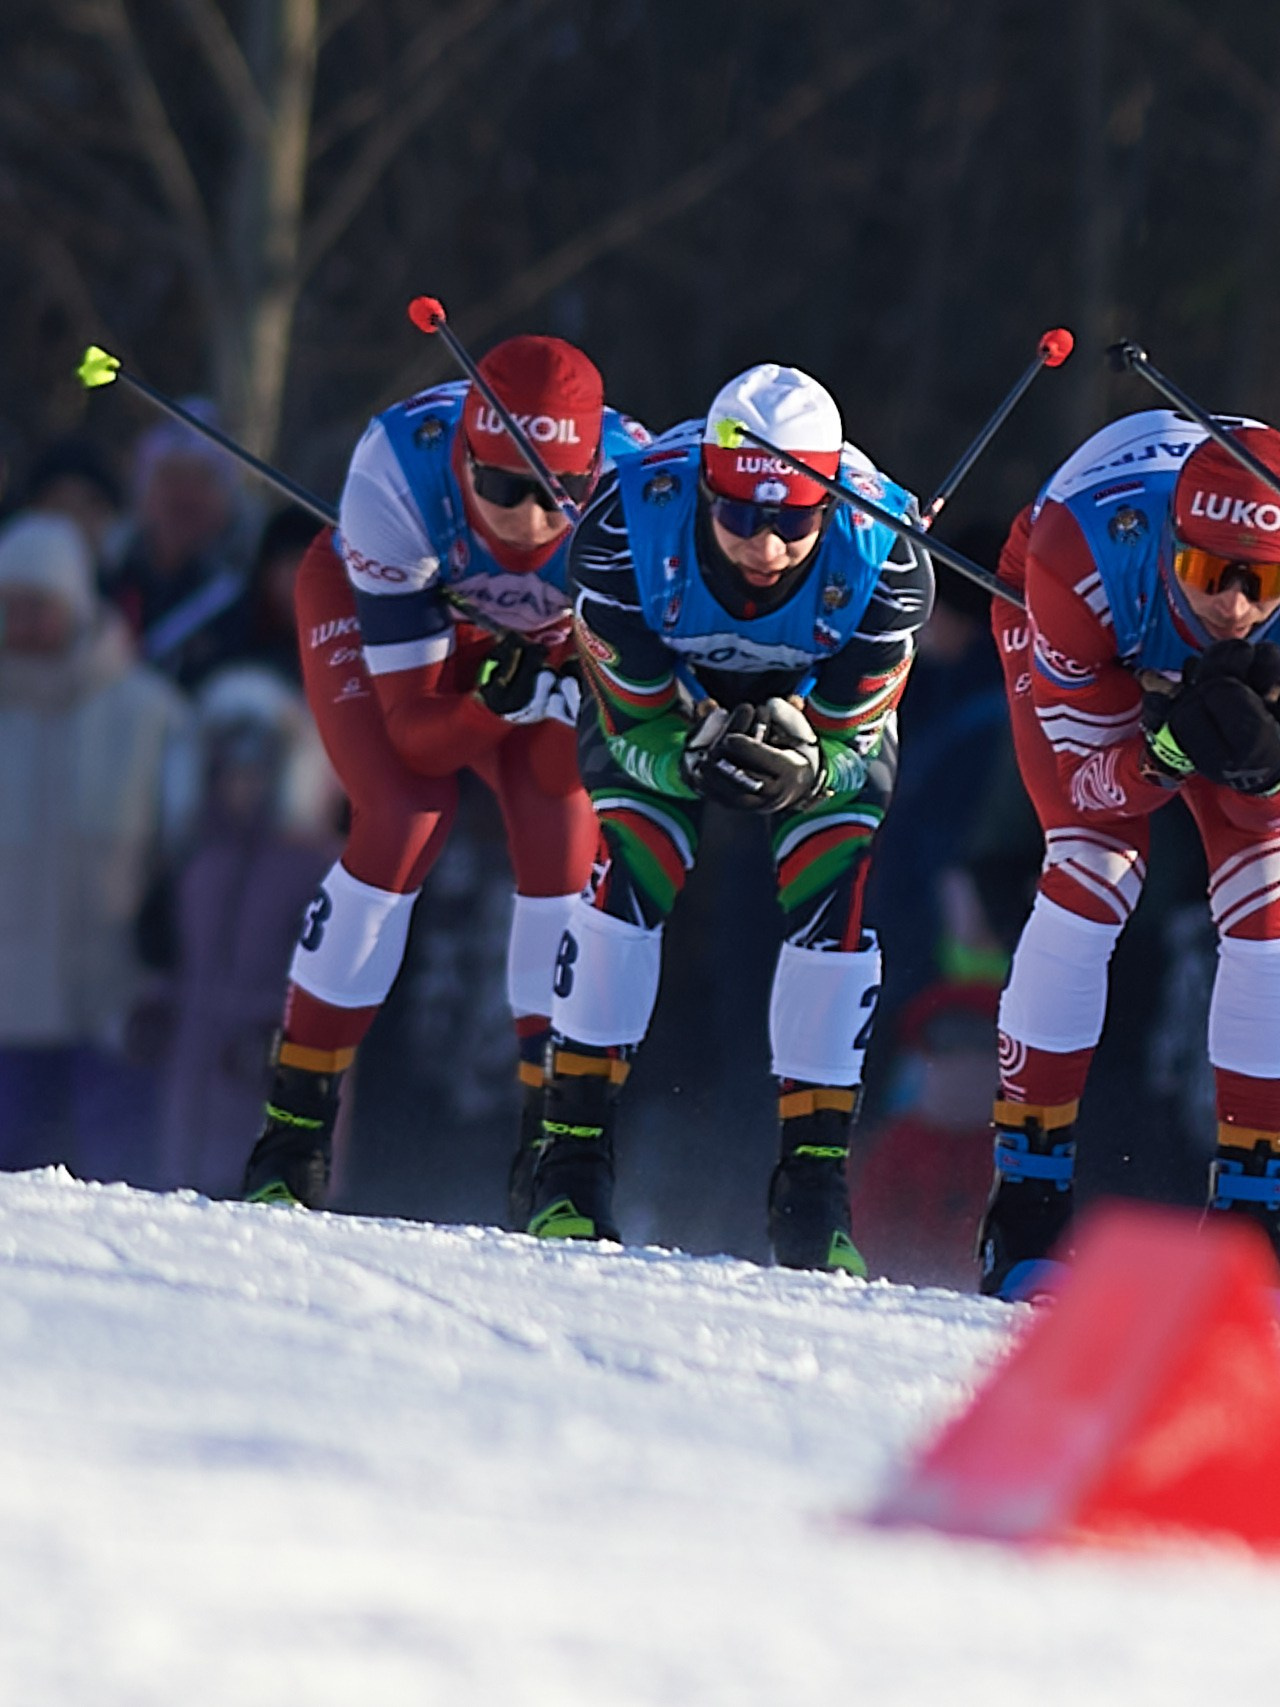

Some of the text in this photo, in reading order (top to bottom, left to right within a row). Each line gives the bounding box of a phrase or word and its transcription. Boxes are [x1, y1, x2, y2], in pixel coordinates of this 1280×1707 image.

[477, 406, 581, 443] LUKOIL
[736, 456, 806, 476] LUKO
[853, 985, 881, 1050] 2
